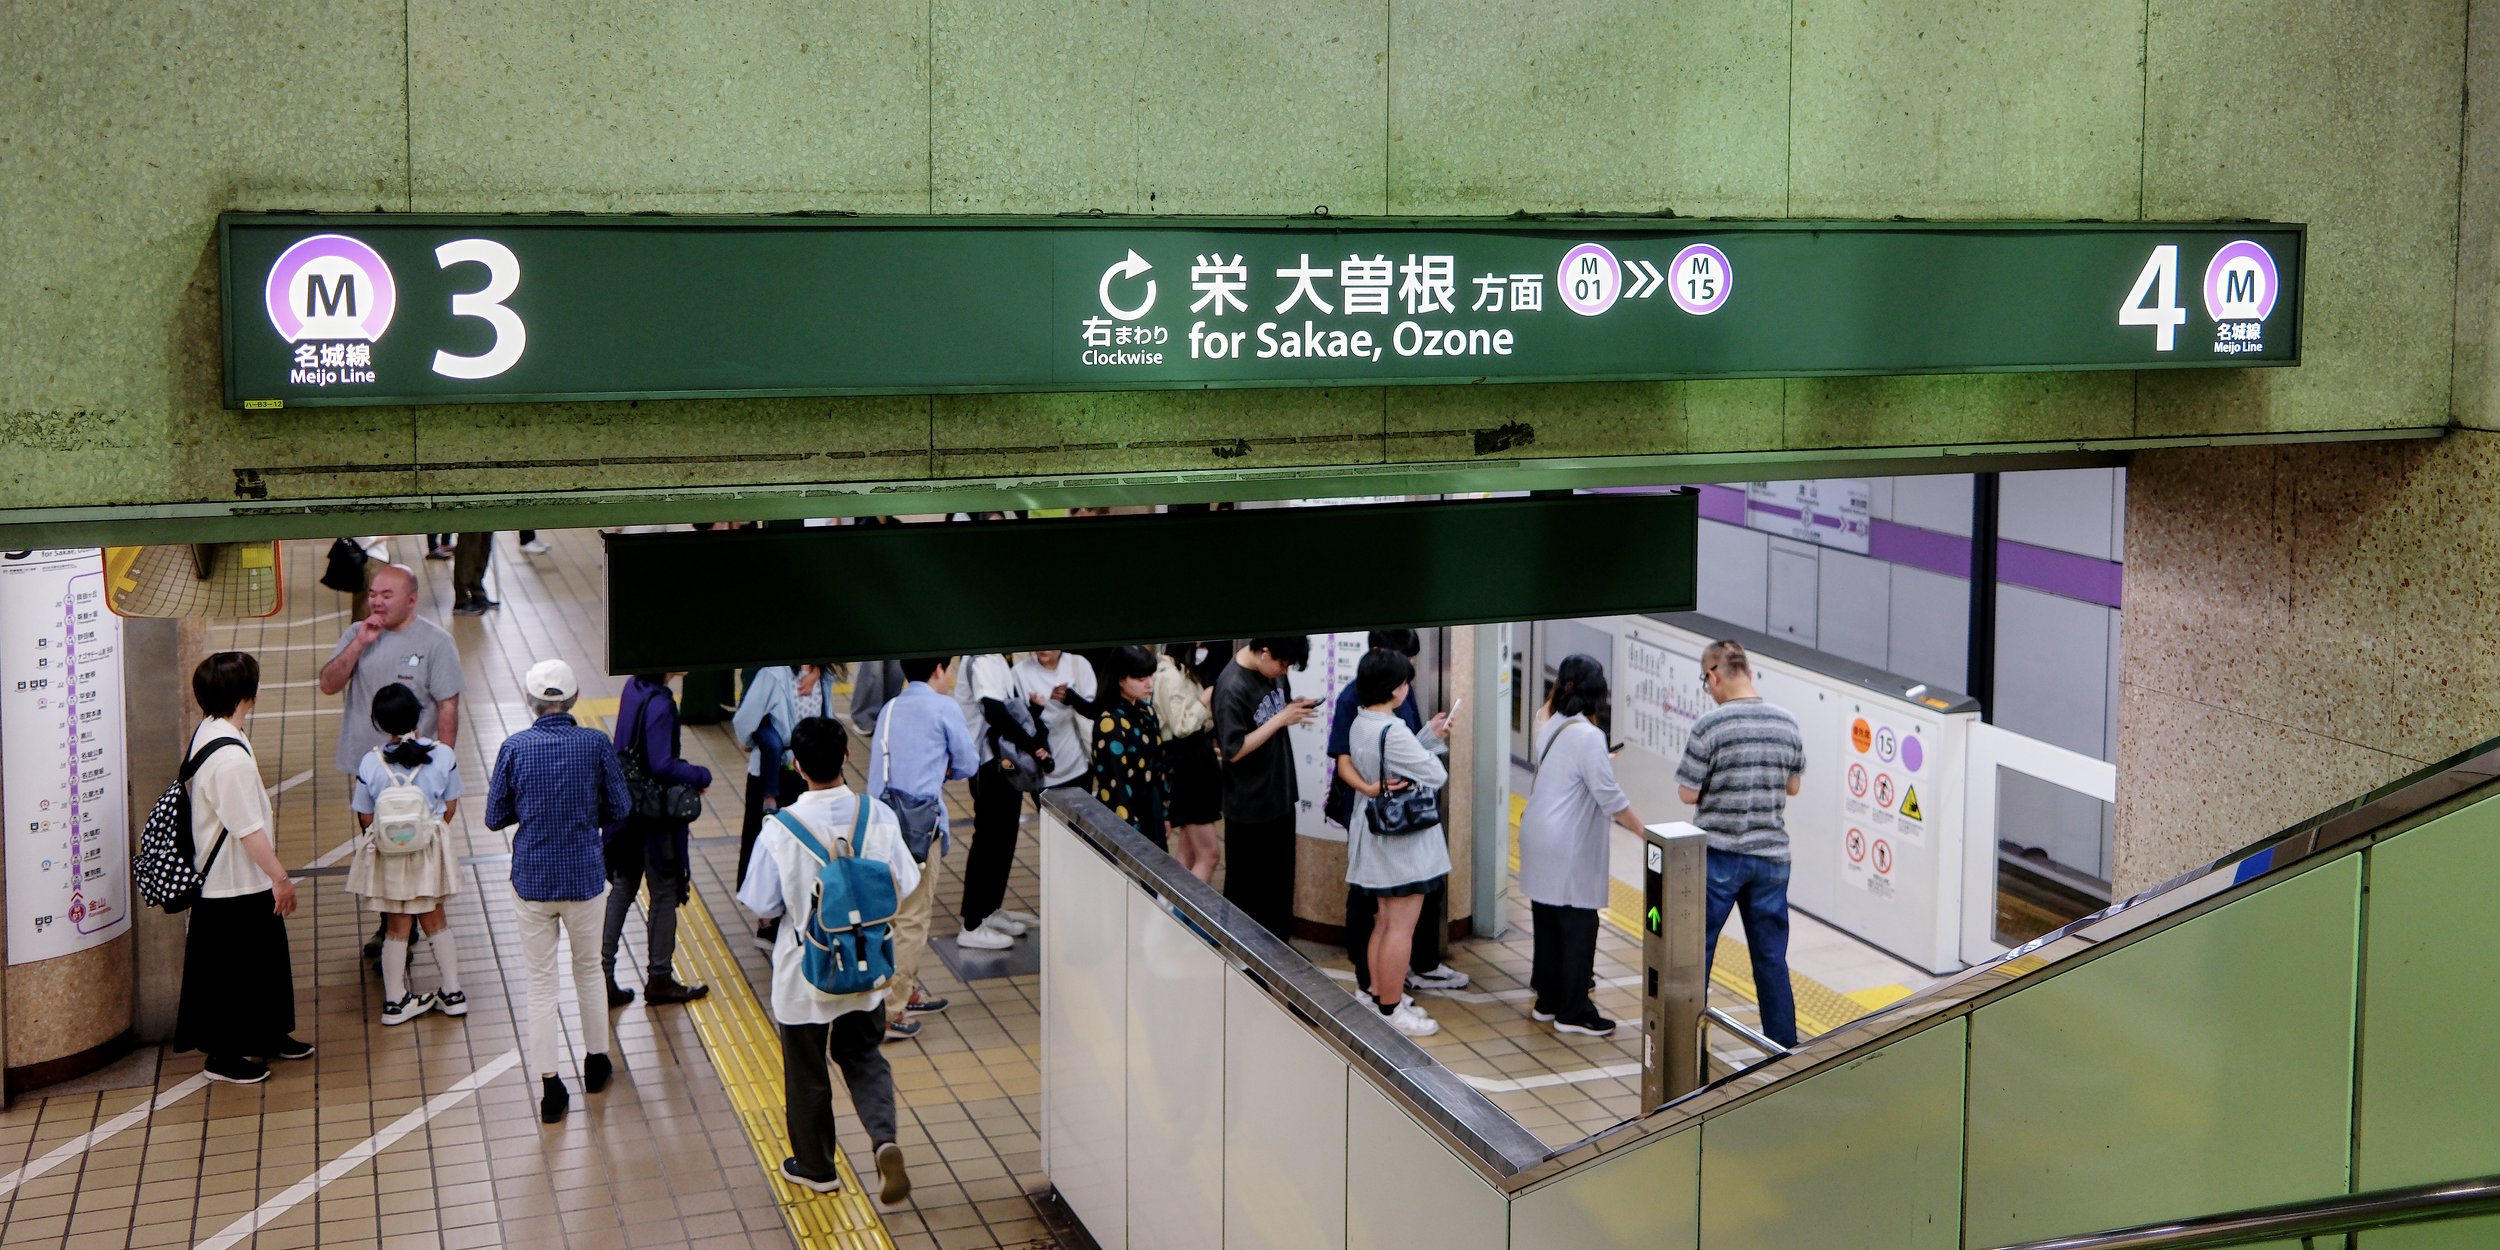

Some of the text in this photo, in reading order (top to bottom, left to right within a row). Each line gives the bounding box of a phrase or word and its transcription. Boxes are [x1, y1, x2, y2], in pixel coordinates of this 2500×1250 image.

[1581, 257, 1599, 275] M
[1692, 257, 1710, 275] M
[1189, 252, 1544, 316] 栄 大曽根 方面
[1575, 279, 1602, 301] 01
[1687, 279, 1715, 301] 15
[2226, 270, 2255, 304] M
[306, 274, 357, 318] M
[2118, 244, 2187, 352] 4
[432, 238, 527, 380] 3
[1082, 315, 1169, 347] 右まわり
[1188, 320, 1514, 363] for Sakae, Ozone
[2217, 322, 2262, 342] 名城線
[294, 343, 371, 368] 名城線
[1082, 349, 1164, 365] Clockwise
[2214, 341, 2264, 355] Meijo Line
[290, 368, 376, 387] Meijo Line
[1879, 735, 1893, 755] 15
